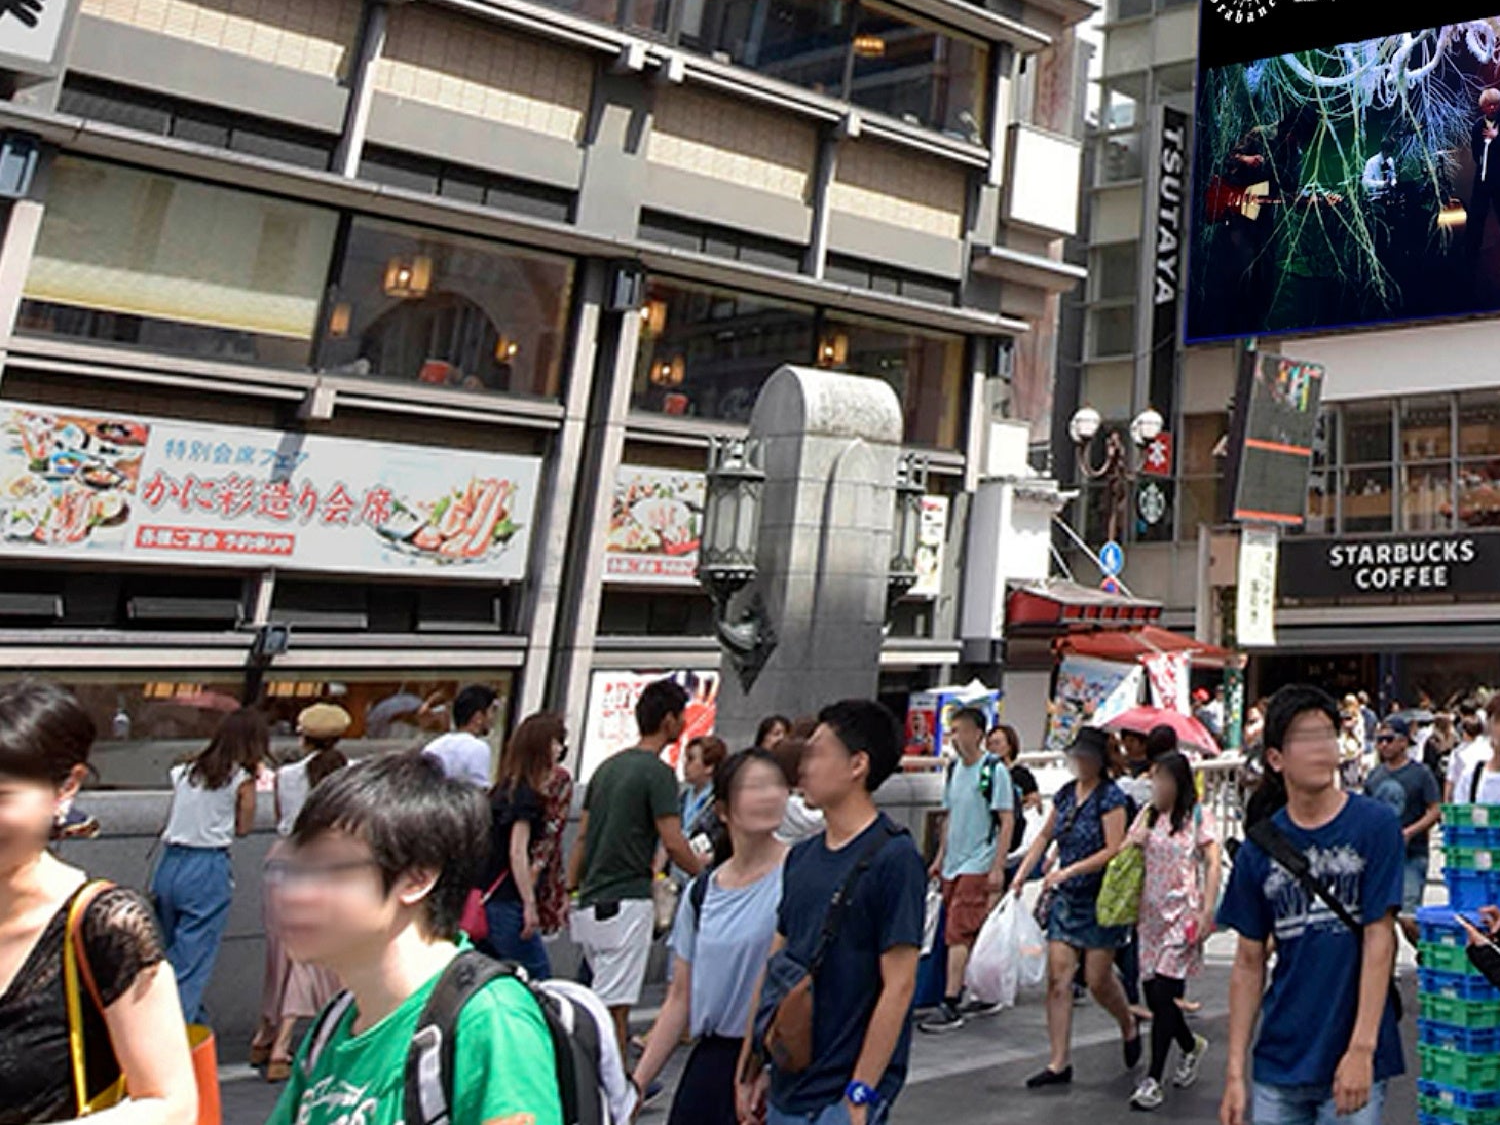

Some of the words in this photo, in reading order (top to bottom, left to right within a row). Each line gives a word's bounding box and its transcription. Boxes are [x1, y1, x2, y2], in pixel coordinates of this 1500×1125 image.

[1155, 127, 1185, 304] TSUTAYA
[1329, 540, 1475, 566] STARBUCKS
[1355, 565, 1448, 589] COFFEE
